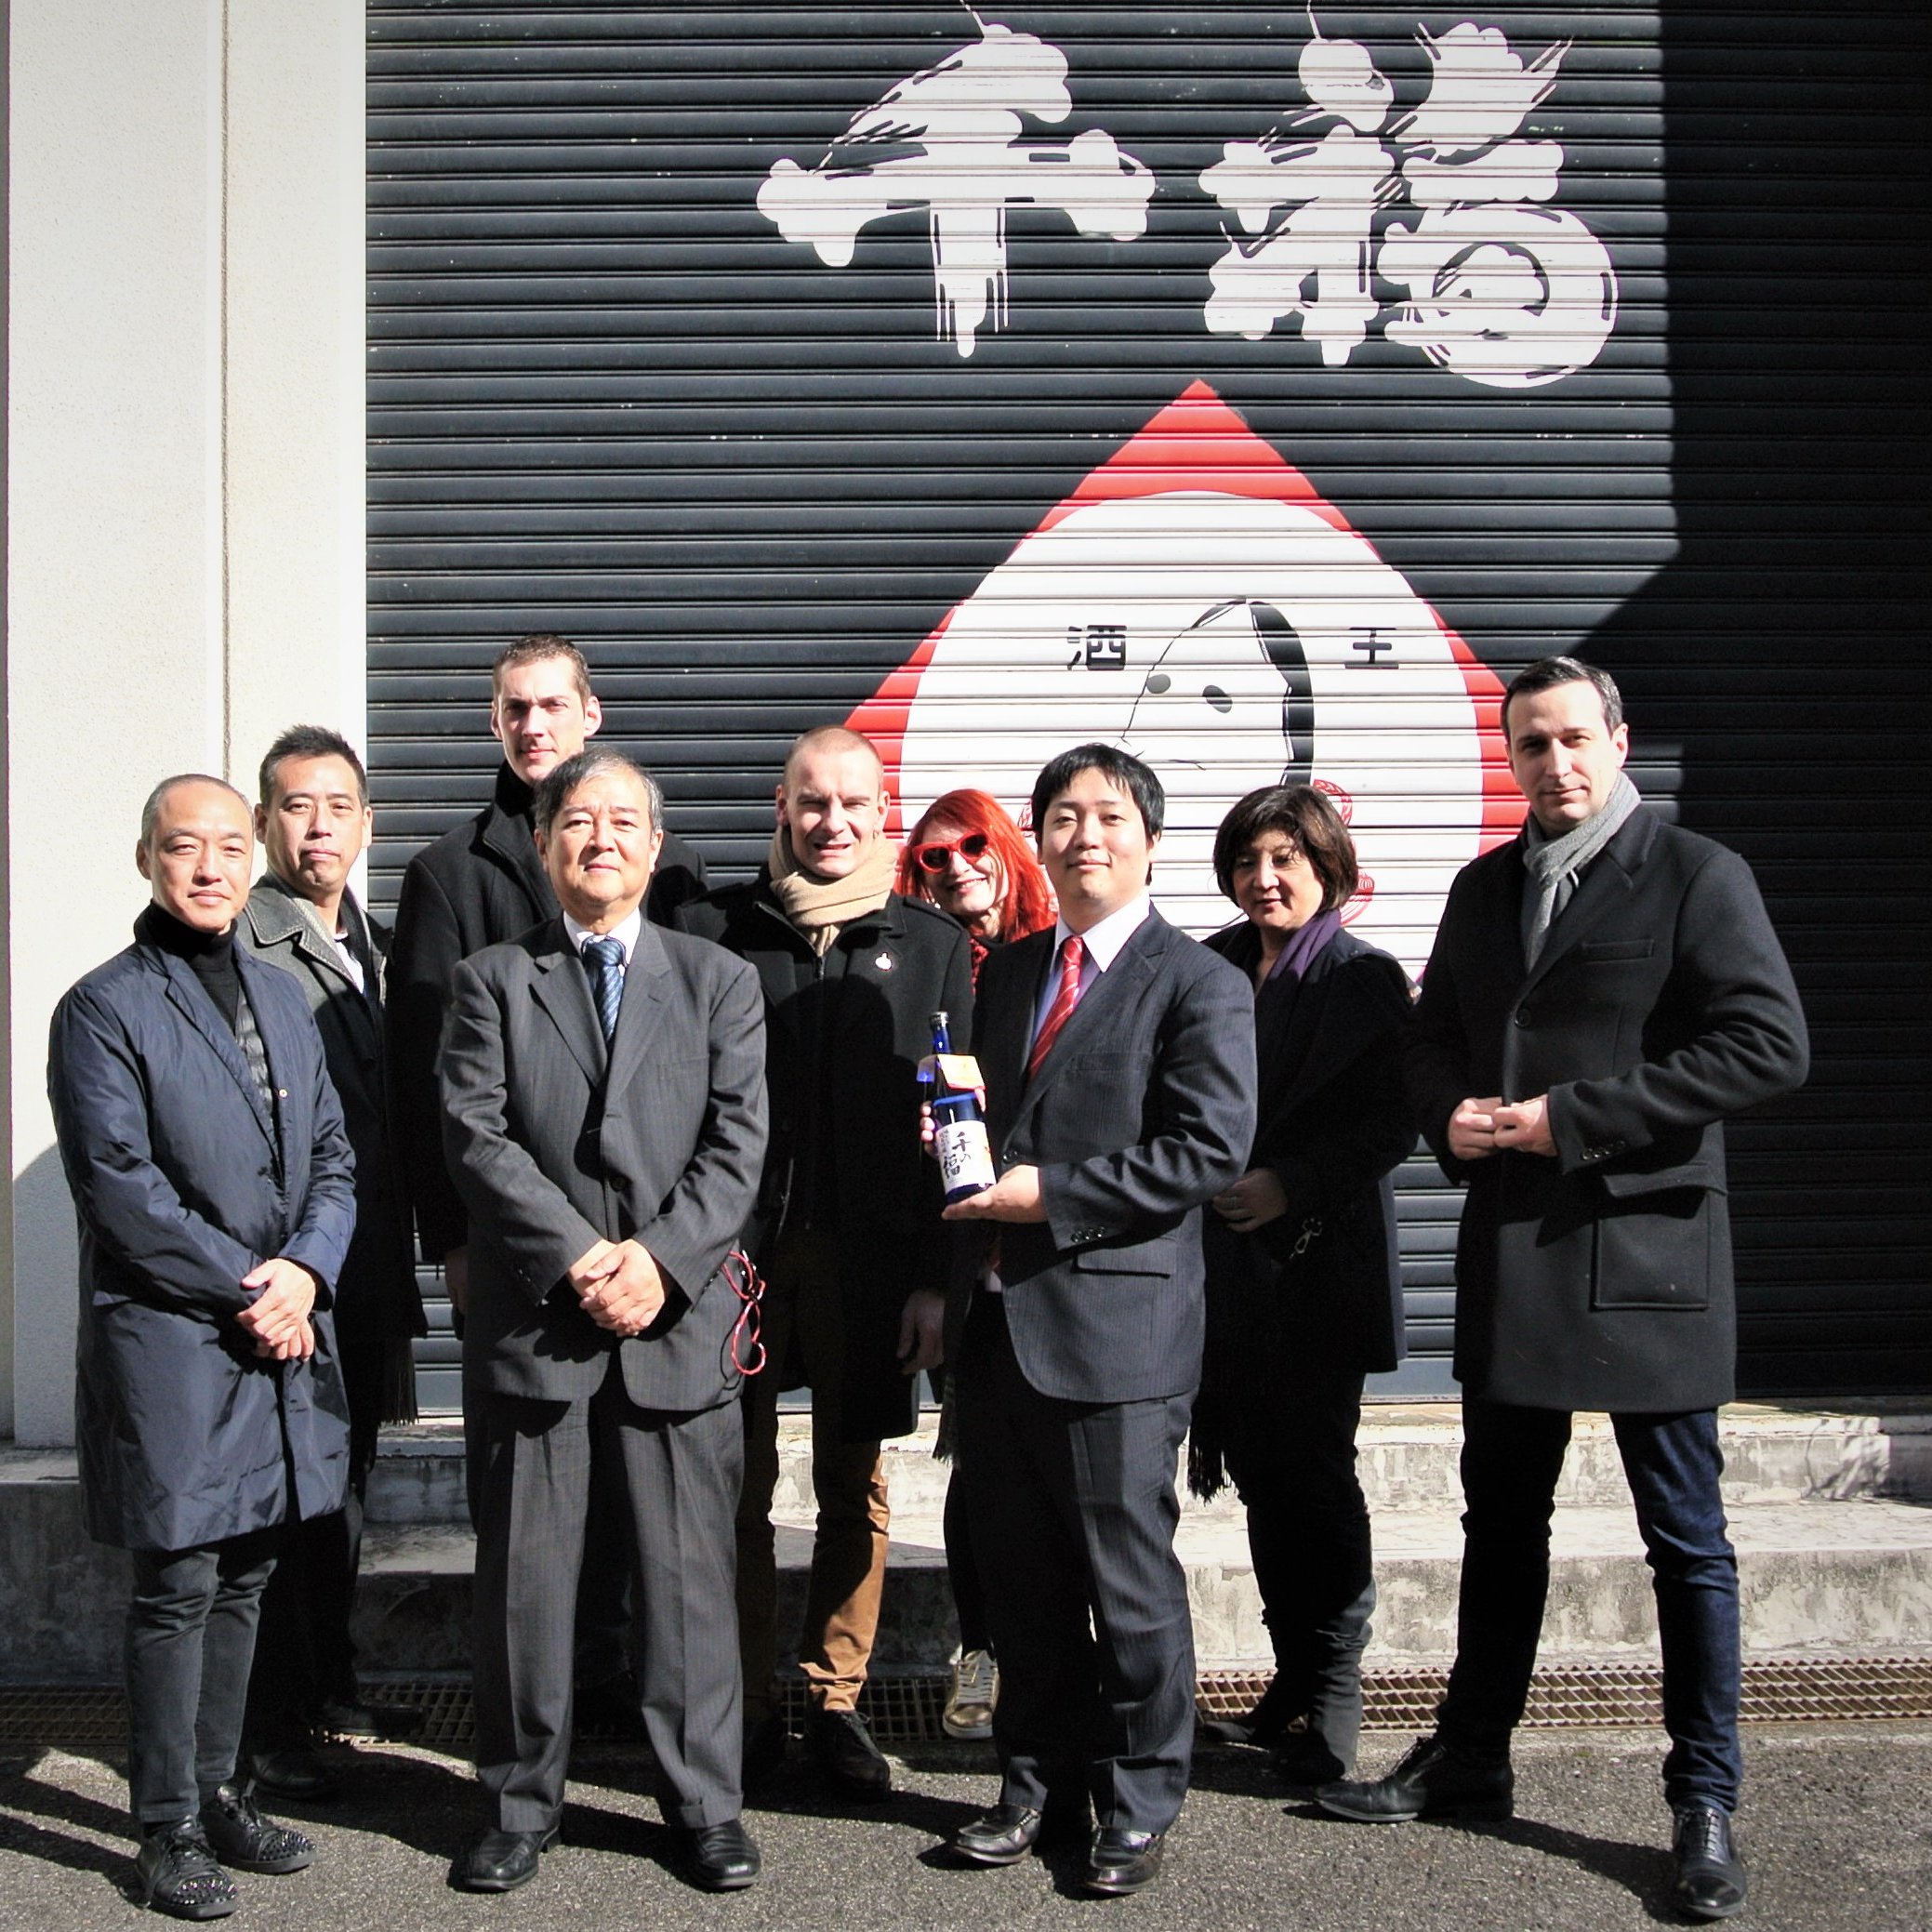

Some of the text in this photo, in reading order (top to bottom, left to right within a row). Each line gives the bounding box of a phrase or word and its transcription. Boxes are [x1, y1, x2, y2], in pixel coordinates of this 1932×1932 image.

[757, 0, 1618, 389] 千福
[1067, 625, 1128, 670] 酒
[1344, 627, 1399, 669] 王
